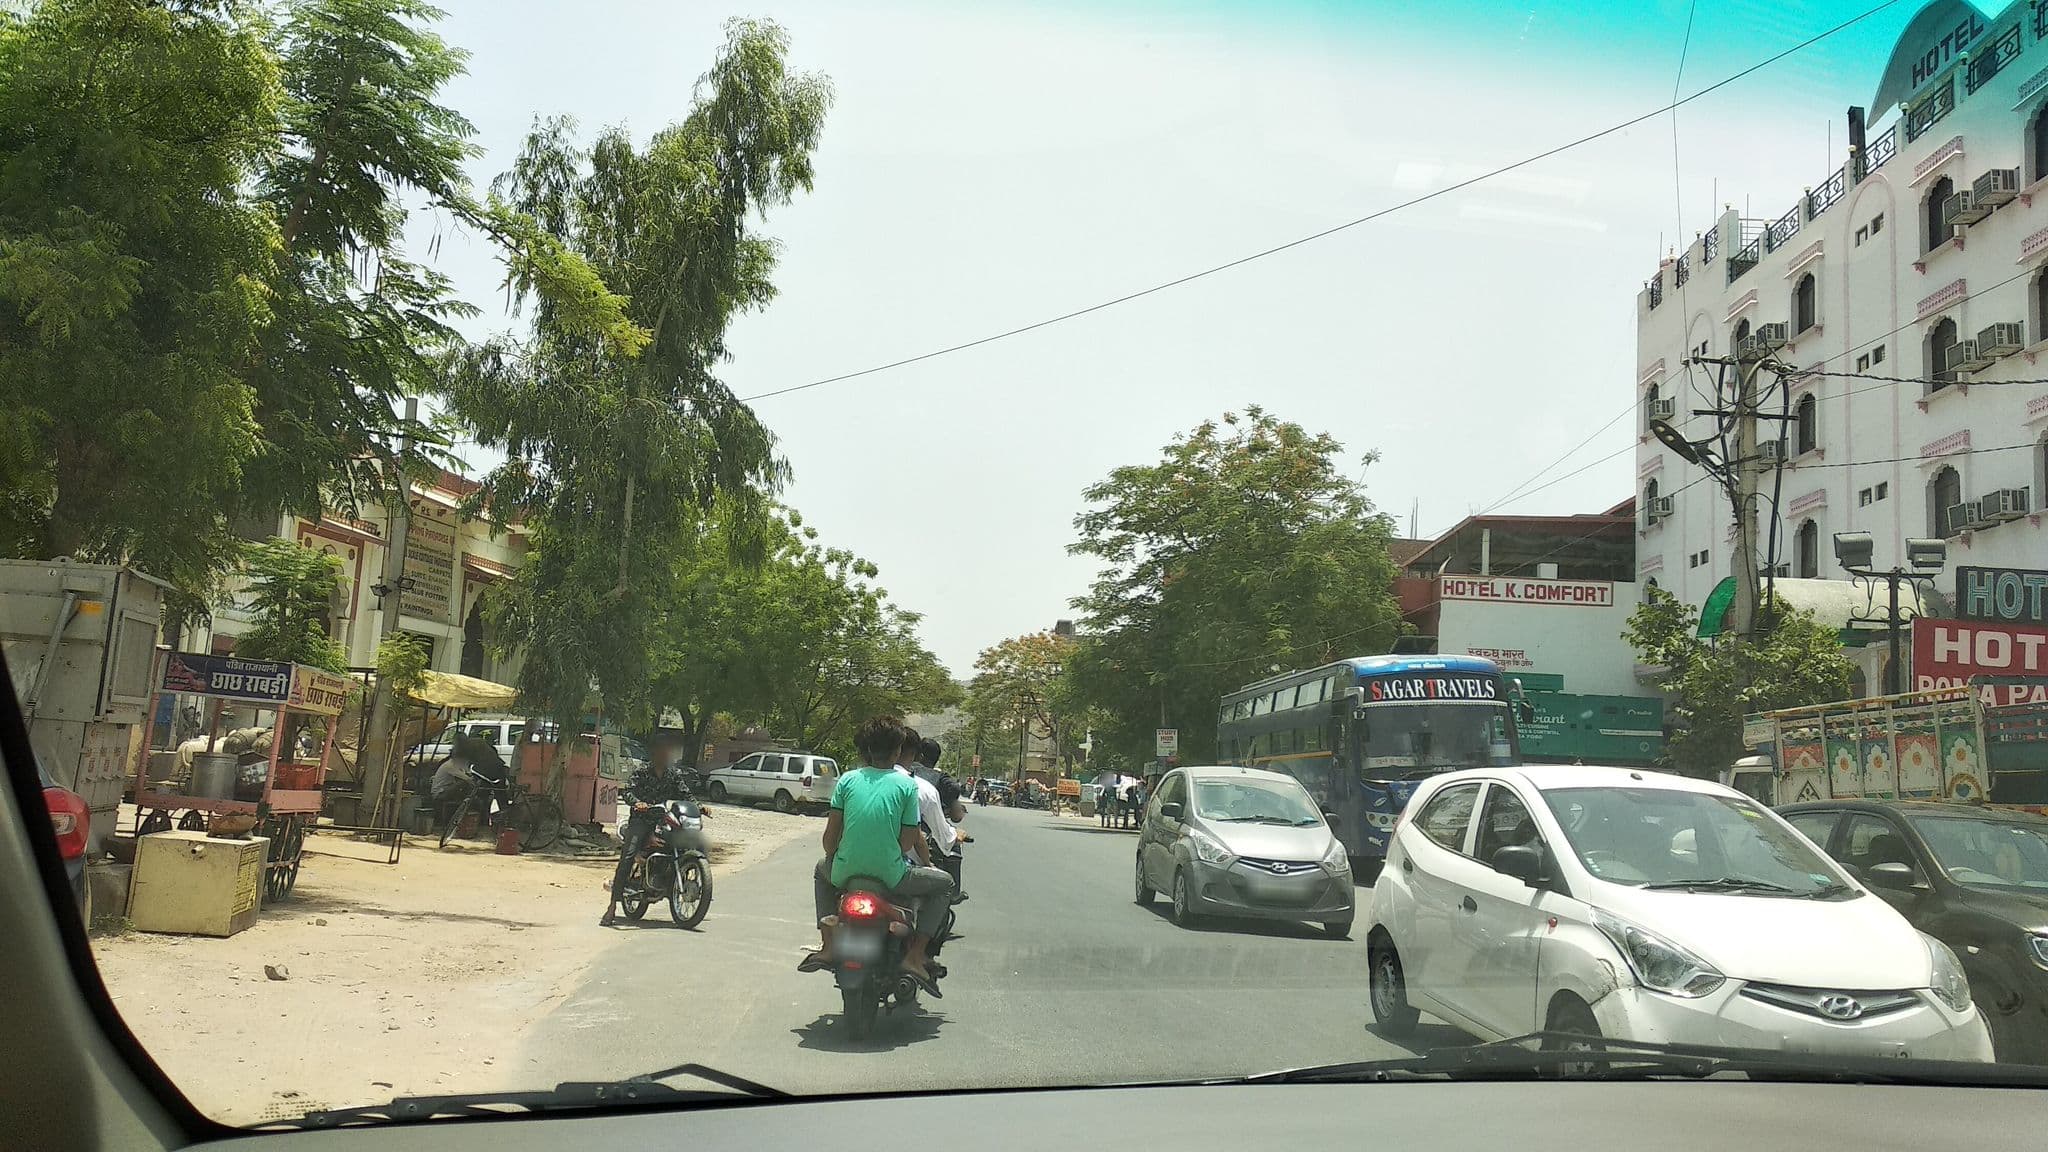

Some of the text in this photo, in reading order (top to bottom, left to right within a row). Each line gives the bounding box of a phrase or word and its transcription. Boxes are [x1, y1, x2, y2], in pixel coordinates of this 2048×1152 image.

[1912, 13, 1984, 90] HOTEL
[1443, 579, 1501, 598] HOTEL
[1967, 570, 2048, 620] HOT
[1502, 649, 1525, 659] भारत
[1934, 627, 2046, 670] HOT
[211, 672, 243, 691] छाछ
[245, 673, 288, 699] राबड़ी
[1371, 678, 1496, 700] SAGAR TRAVELS
